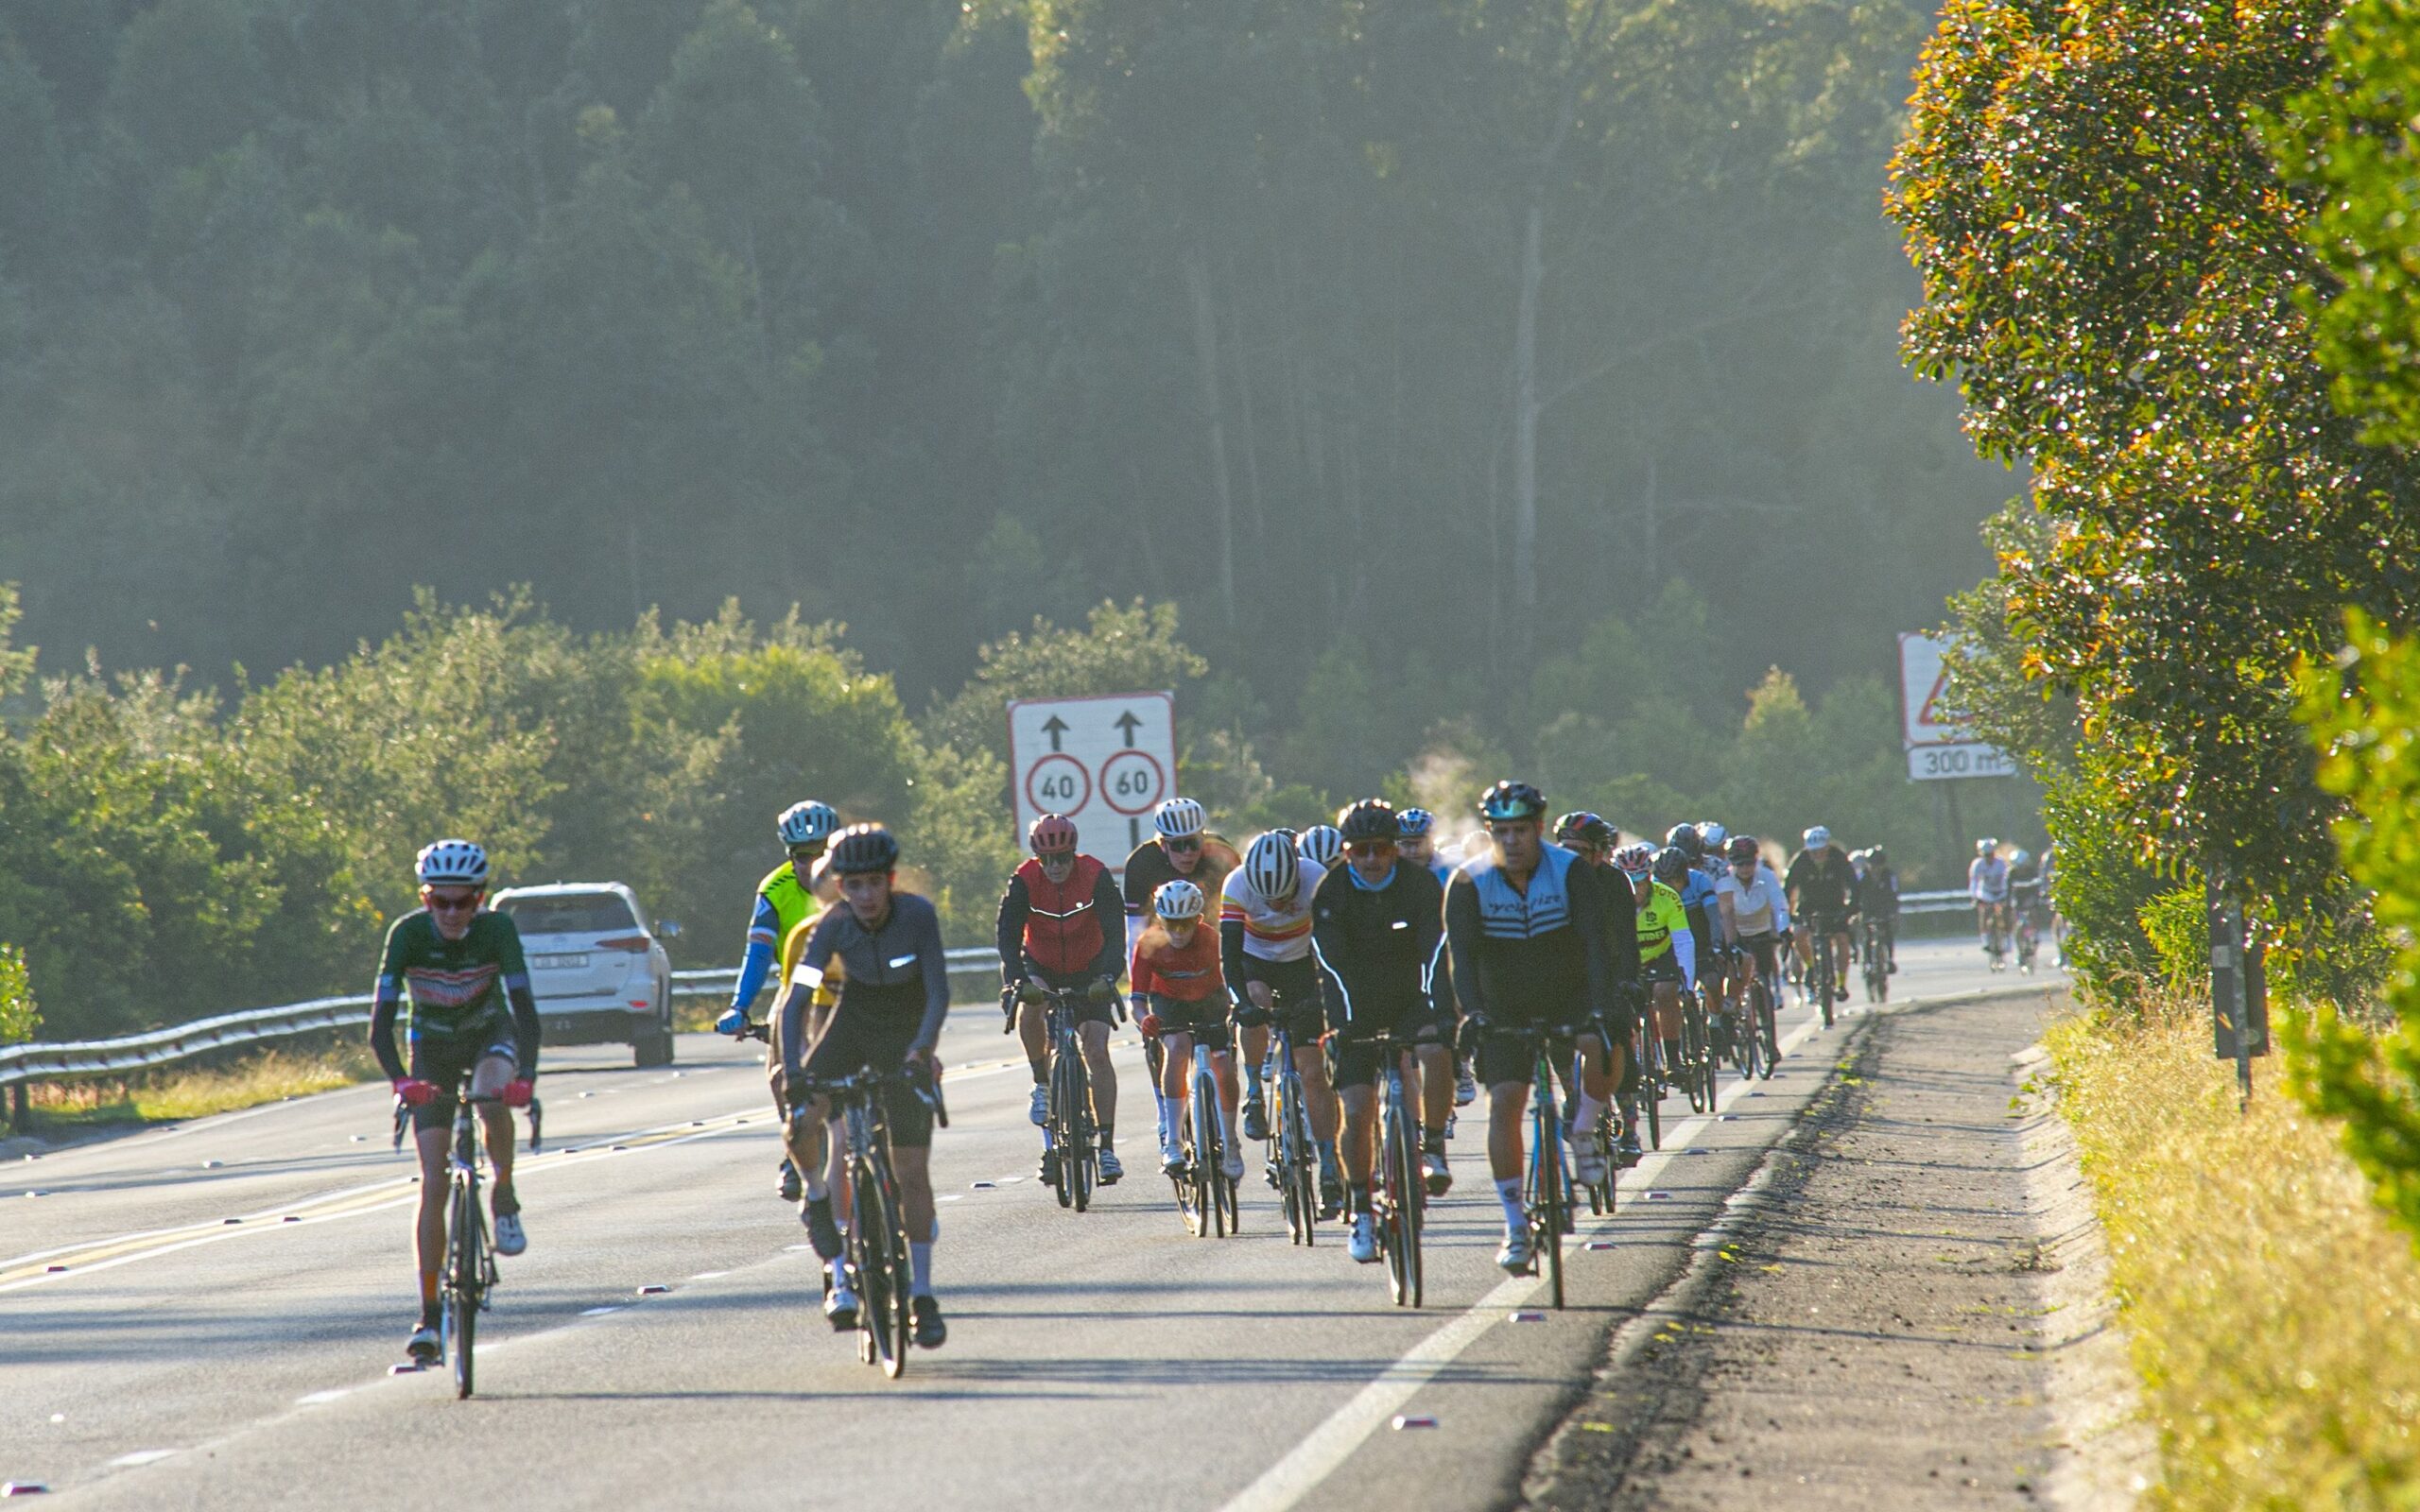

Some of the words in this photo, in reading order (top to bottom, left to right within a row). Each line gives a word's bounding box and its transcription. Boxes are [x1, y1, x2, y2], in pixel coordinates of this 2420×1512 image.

[1926, 750, 1969, 774] 300
[1976, 754, 2001, 771] m
[1042, 776, 1074, 799] 40
[1116, 771, 1148, 795] 60
